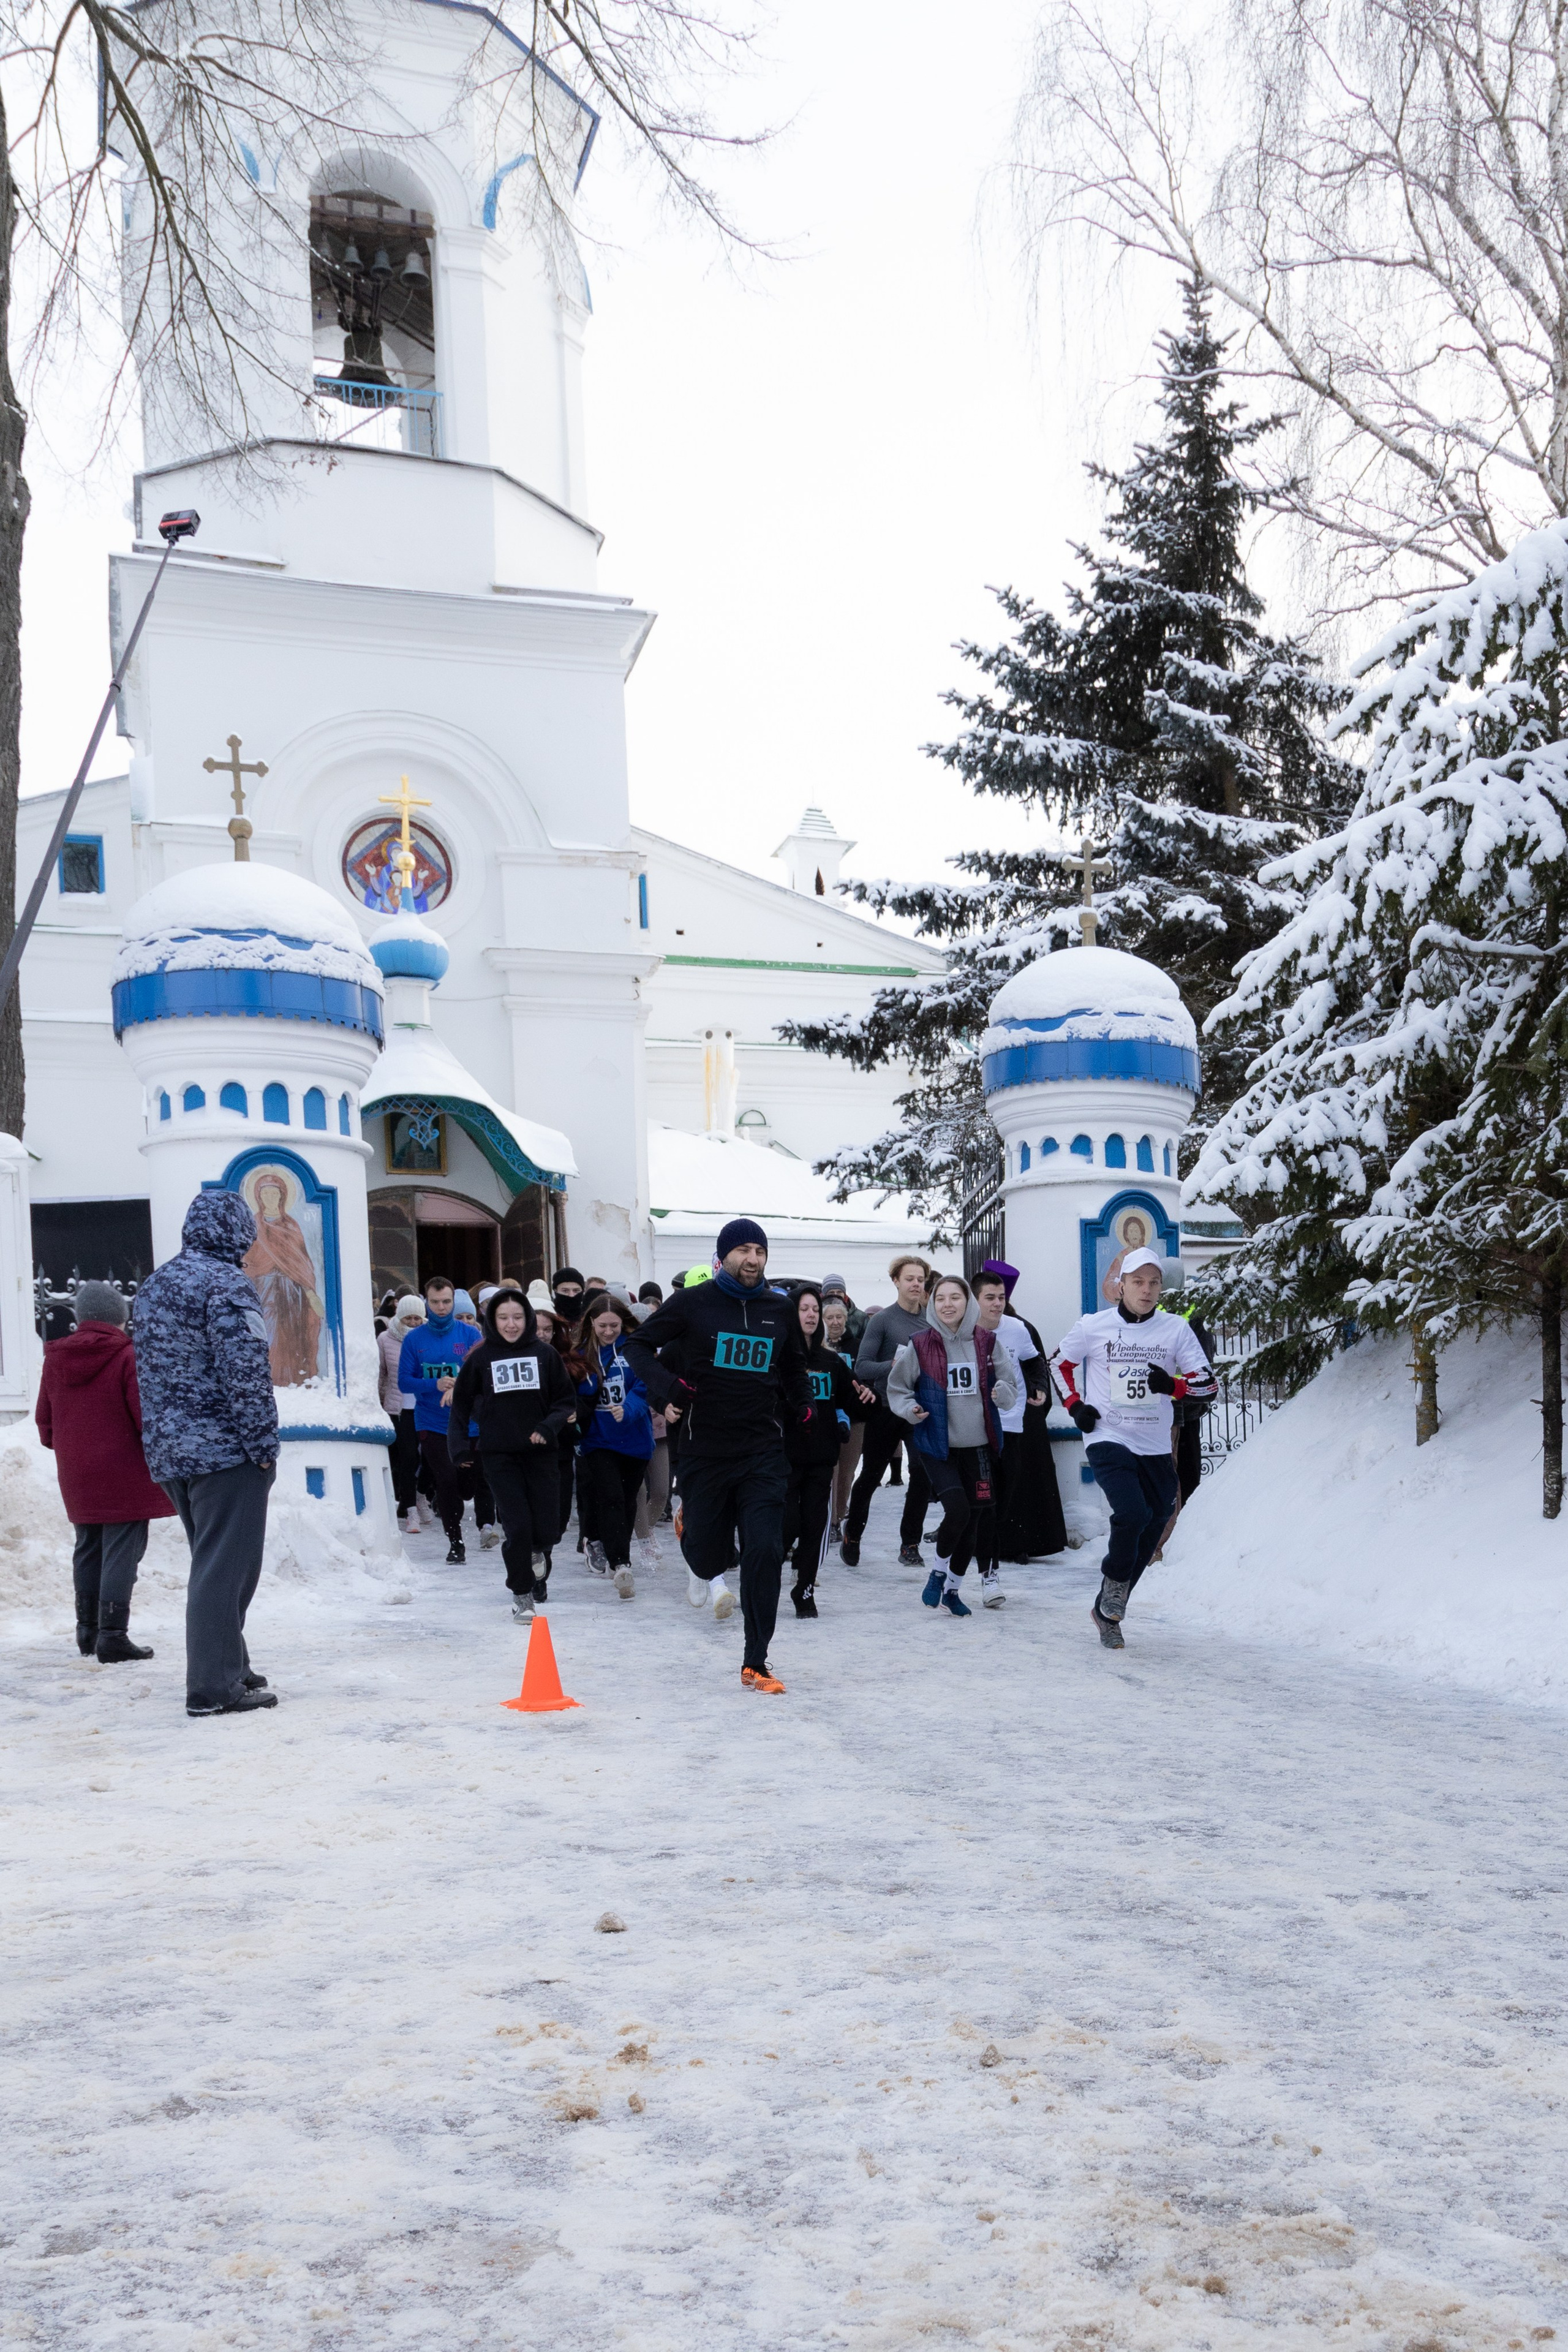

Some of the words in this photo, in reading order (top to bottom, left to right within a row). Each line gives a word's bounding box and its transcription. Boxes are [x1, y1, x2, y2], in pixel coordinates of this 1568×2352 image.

[722, 1337, 768, 1368] 186
[426, 1365, 454, 1378] 173
[496, 1362, 533, 1384] 315
[948, 1367, 972, 1388] 19
[1131, 1368, 1152, 1377] asic
[600, 1385, 623, 1405] 93
[809, 1375, 829, 1396] 91
[1126, 1380, 1146, 1399] 55
